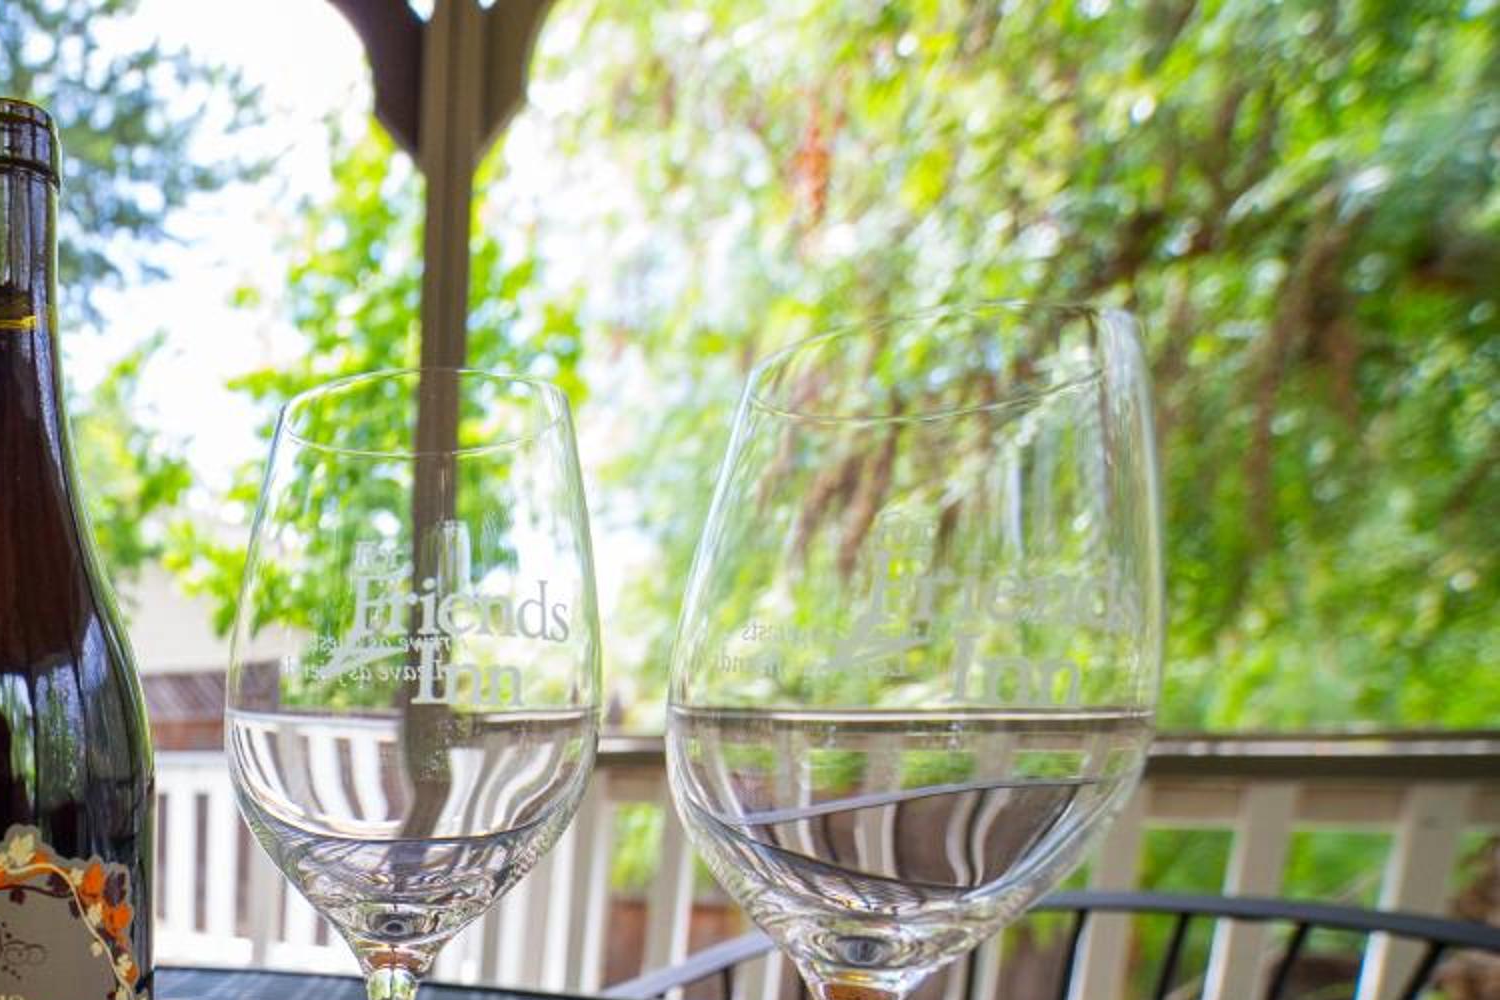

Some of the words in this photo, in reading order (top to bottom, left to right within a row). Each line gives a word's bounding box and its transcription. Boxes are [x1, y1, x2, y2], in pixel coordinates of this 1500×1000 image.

[350, 574, 570, 642] Friends
[410, 633, 524, 706] Inn
[950, 634, 1080, 706] Inn
